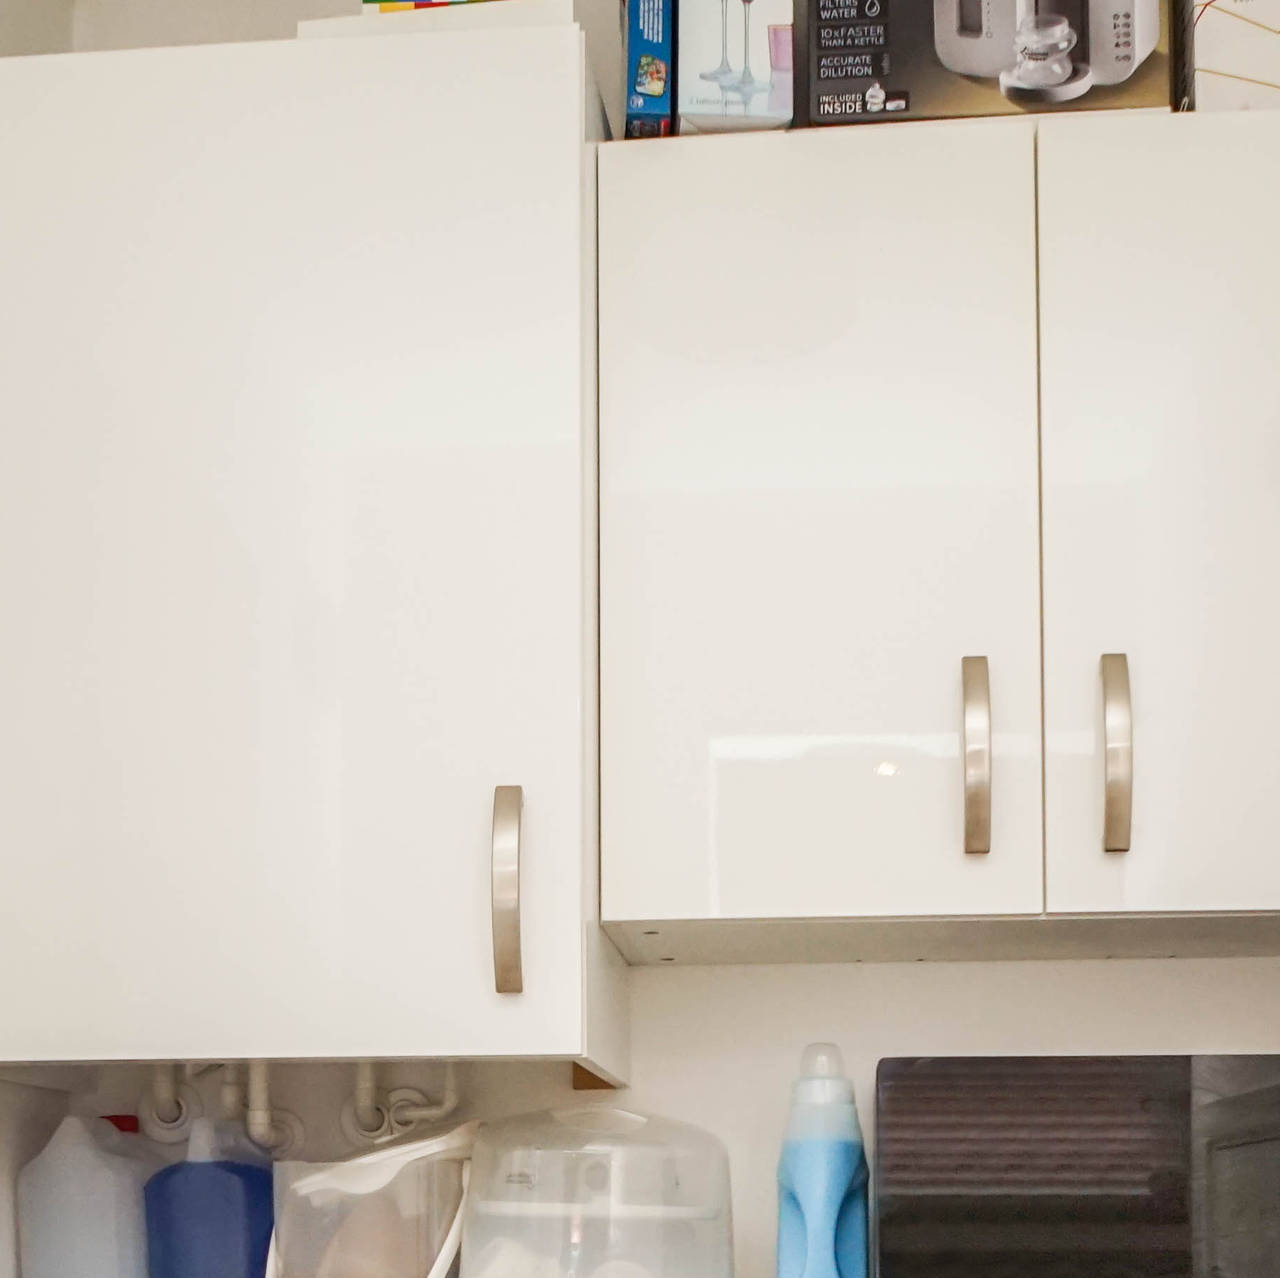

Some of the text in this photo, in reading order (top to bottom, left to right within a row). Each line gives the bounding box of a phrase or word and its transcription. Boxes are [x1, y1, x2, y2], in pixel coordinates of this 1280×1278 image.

[820, 0, 858, 8] FILTERS
[821, 8, 858, 19] WATER
[821, 38, 845, 47] THAN
[854, 36, 885, 45] KETTLE
[821, 55, 872, 66] ACCURATE
[821, 66, 872, 78] DILUTION
[820, 93, 863, 102] INCLUDED
[820, 101, 863, 114] INSIDE
